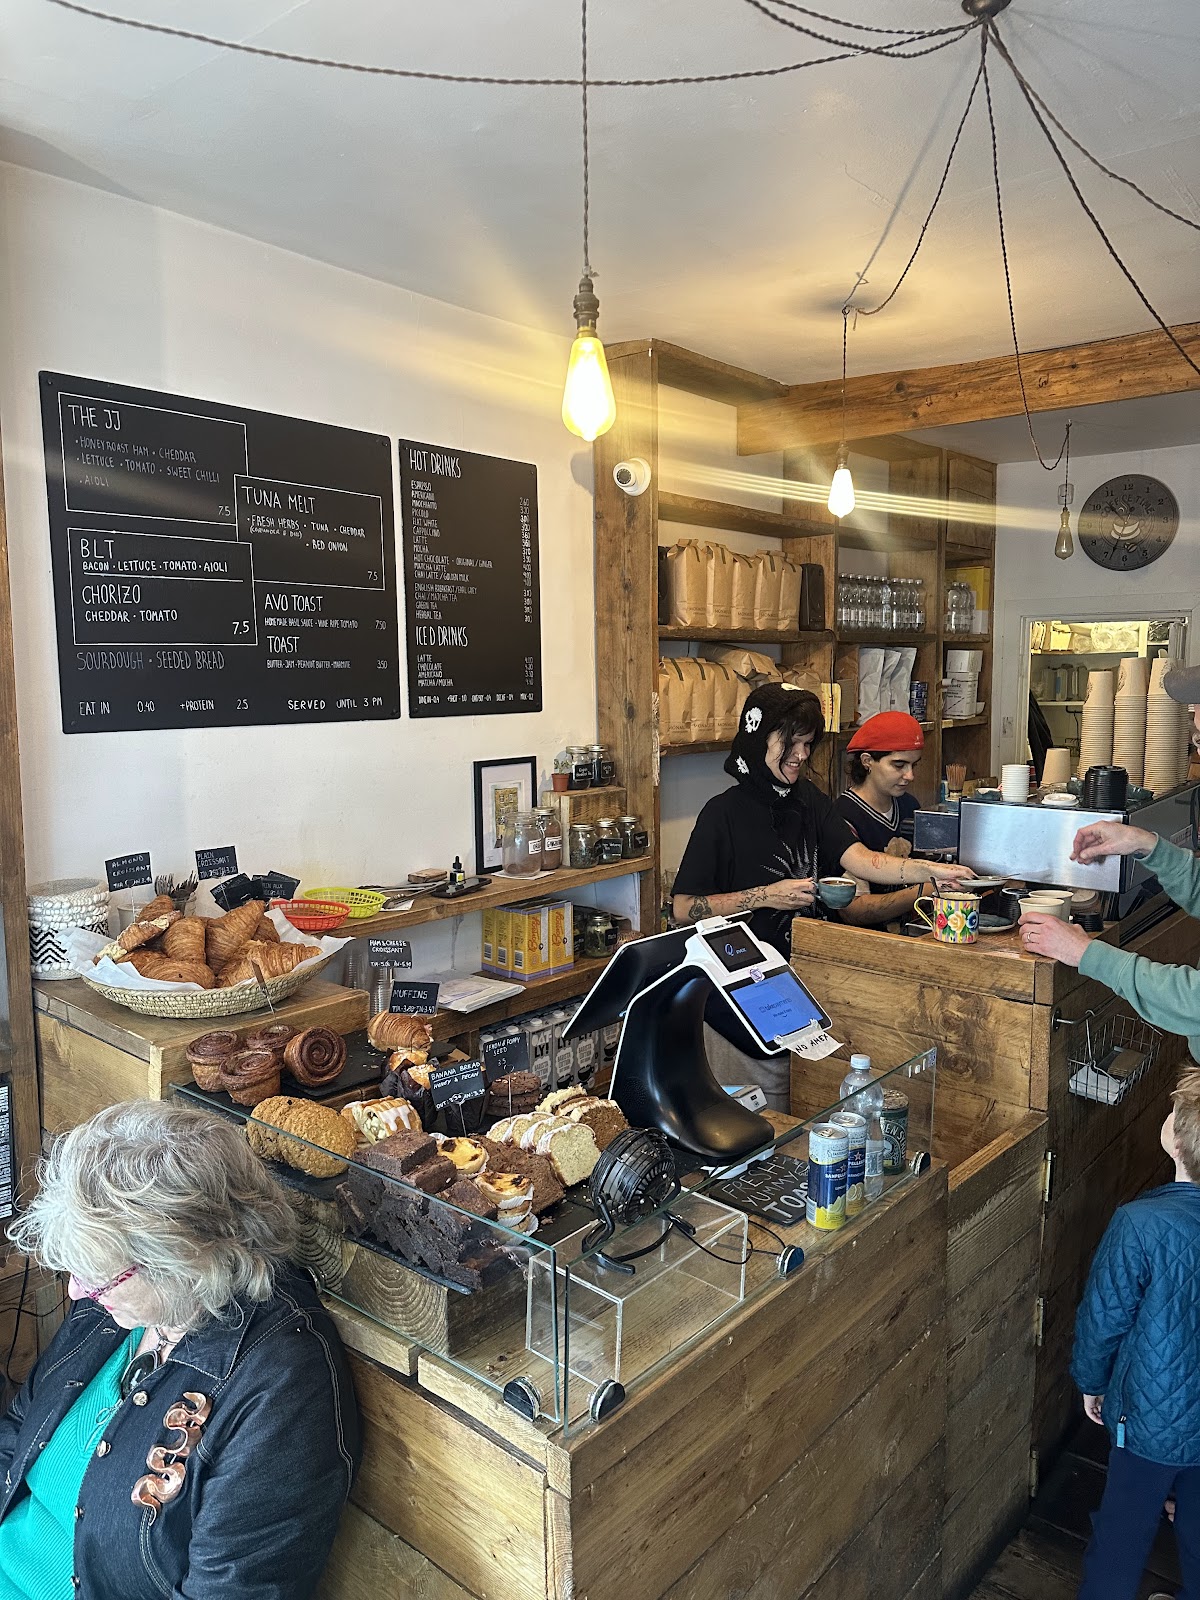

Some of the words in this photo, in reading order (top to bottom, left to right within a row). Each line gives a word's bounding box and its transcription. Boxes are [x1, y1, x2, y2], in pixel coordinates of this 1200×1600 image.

[68, 404, 98, 428] THE
[104, 409, 121, 431] JJ
[133, 445, 149, 457] HAM
[159, 447, 196, 464] CHEDDAR
[409, 448, 428, 472] HOT
[430, 452, 461, 479] DRINKS
[81, 452, 115, 468] LETTUCE
[125, 459, 155, 474] TOMATO
[167, 465, 192, 480] SWEET
[196, 469, 220, 483] CHILLI
[85, 475, 109, 487] AIOLI
[241, 486, 281, 509] TUNA
[288, 494, 315, 514] MELT
[1136, 495, 1155, 514] TIME
[252, 515, 275, 527] FRESH
[278, 518, 299, 530] HERBS
[310, 521, 329, 533] TUNA
[340, 525, 365, 538] CHEDDAR
[80, 538, 114, 559] BLT
[328, 541, 348, 552] ONION
[413, 544, 429, 553] MOCHA
[82, 561, 109, 571] BACON
[118, 560, 157, 571] LETTUCE
[163, 560, 197, 571] TOMATO
[204, 561, 228, 572] AIOLI
[82, 584, 141, 604] CHORIZO
[265, 593, 288, 611] AVO
[291, 594, 323, 612] TOAST
[85, 610, 130, 623] CHEDDAR
[140, 610, 178, 622] TOMATO
[232, 620, 250, 635] 7.5
[437, 626, 468, 647] DRINKS
[266, 635, 300, 653] TOAST
[77, 652, 144, 670] SOURDOUGH
[156, 650, 192, 670] SEEDED
[195, 650, 225, 670] BREAD
[417, 654, 432, 663] LATTE
[79, 701, 96, 715] EAT
[100, 701, 110, 714] IN
[288, 699, 326, 710] SERVED
[336, 698, 357, 709] UNTIL
[364, 698, 369, 707] 3
[372, 697, 383, 706] PM
[112, 855, 144, 868] ALMOND
[197, 852, 214, 860] PLAIN
[198, 856, 230, 867] CROISSANT
[112, 865, 150, 876] CROISSANT
[393, 990, 428, 999] MUFFINS
[485, 1041, 502, 1052] LEMON
[493, 1047, 508, 1056] SEED
[535, 1043, 549, 1058] LY!
[795, 1044, 808, 1053] NO
[810, 1033, 828, 1046] AMEX
[431, 1068, 456, 1081] BANANA
[459, 1062, 480, 1071] BREAD
[433, 1079, 451, 1089] HONEY
[461, 1072, 479, 1080] PECAN
[721, 1162, 785, 1199] FRESH
[741, 1171, 798, 1206] YUMMY
